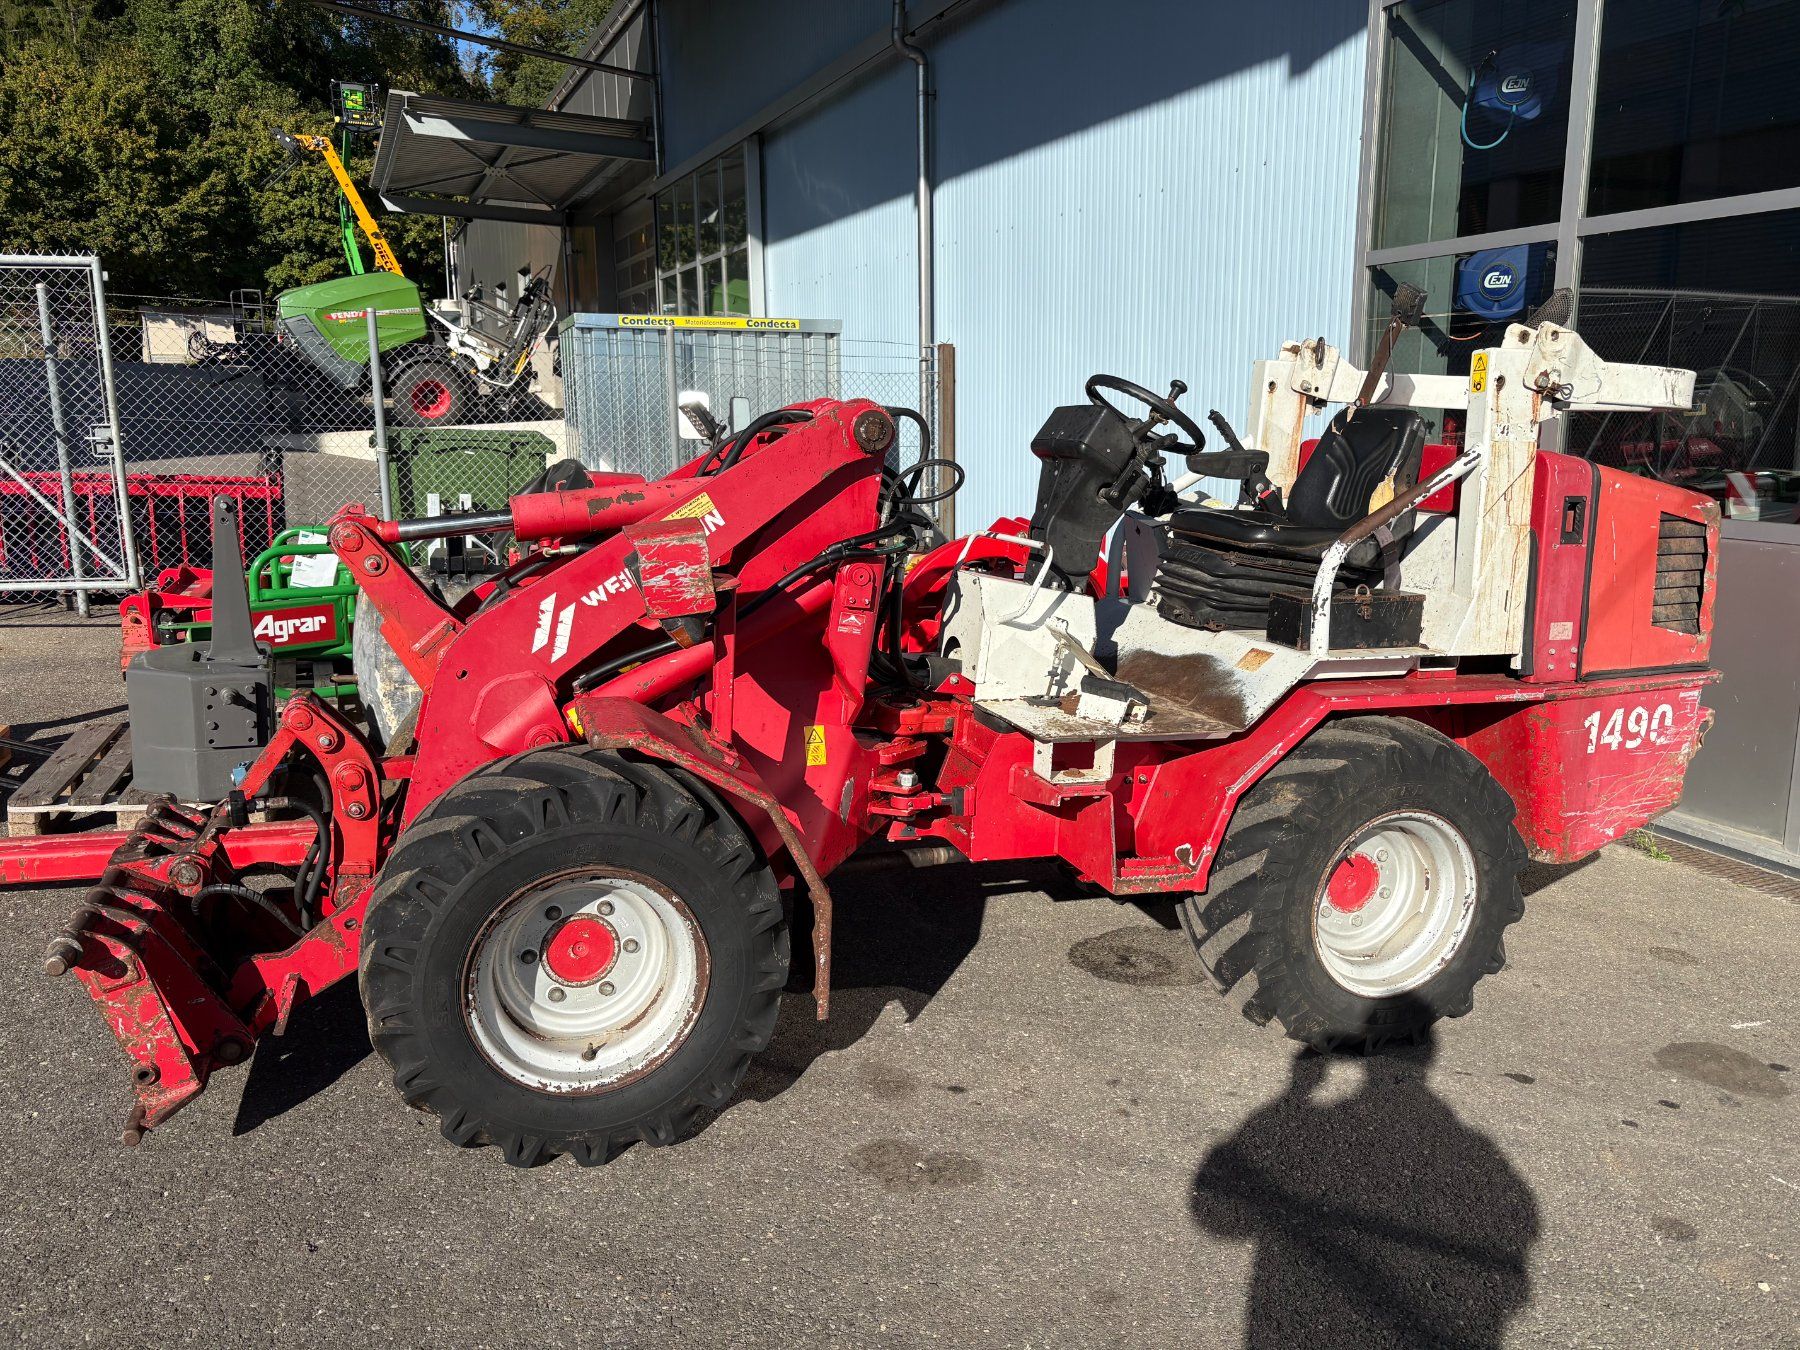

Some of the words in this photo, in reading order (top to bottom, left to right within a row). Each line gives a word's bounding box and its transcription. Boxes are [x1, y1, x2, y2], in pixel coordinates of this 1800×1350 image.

[1501, 75, 1530, 93] CEJN
[1483, 271, 1512, 289] CEJN
[329, 310, 364, 320] FENDT
[621, 316, 675, 326] Condecta
[746, 319, 797, 329] Condecta
[253, 614, 327, 643] Agrar
[1583, 703, 1674, 755] 1490
